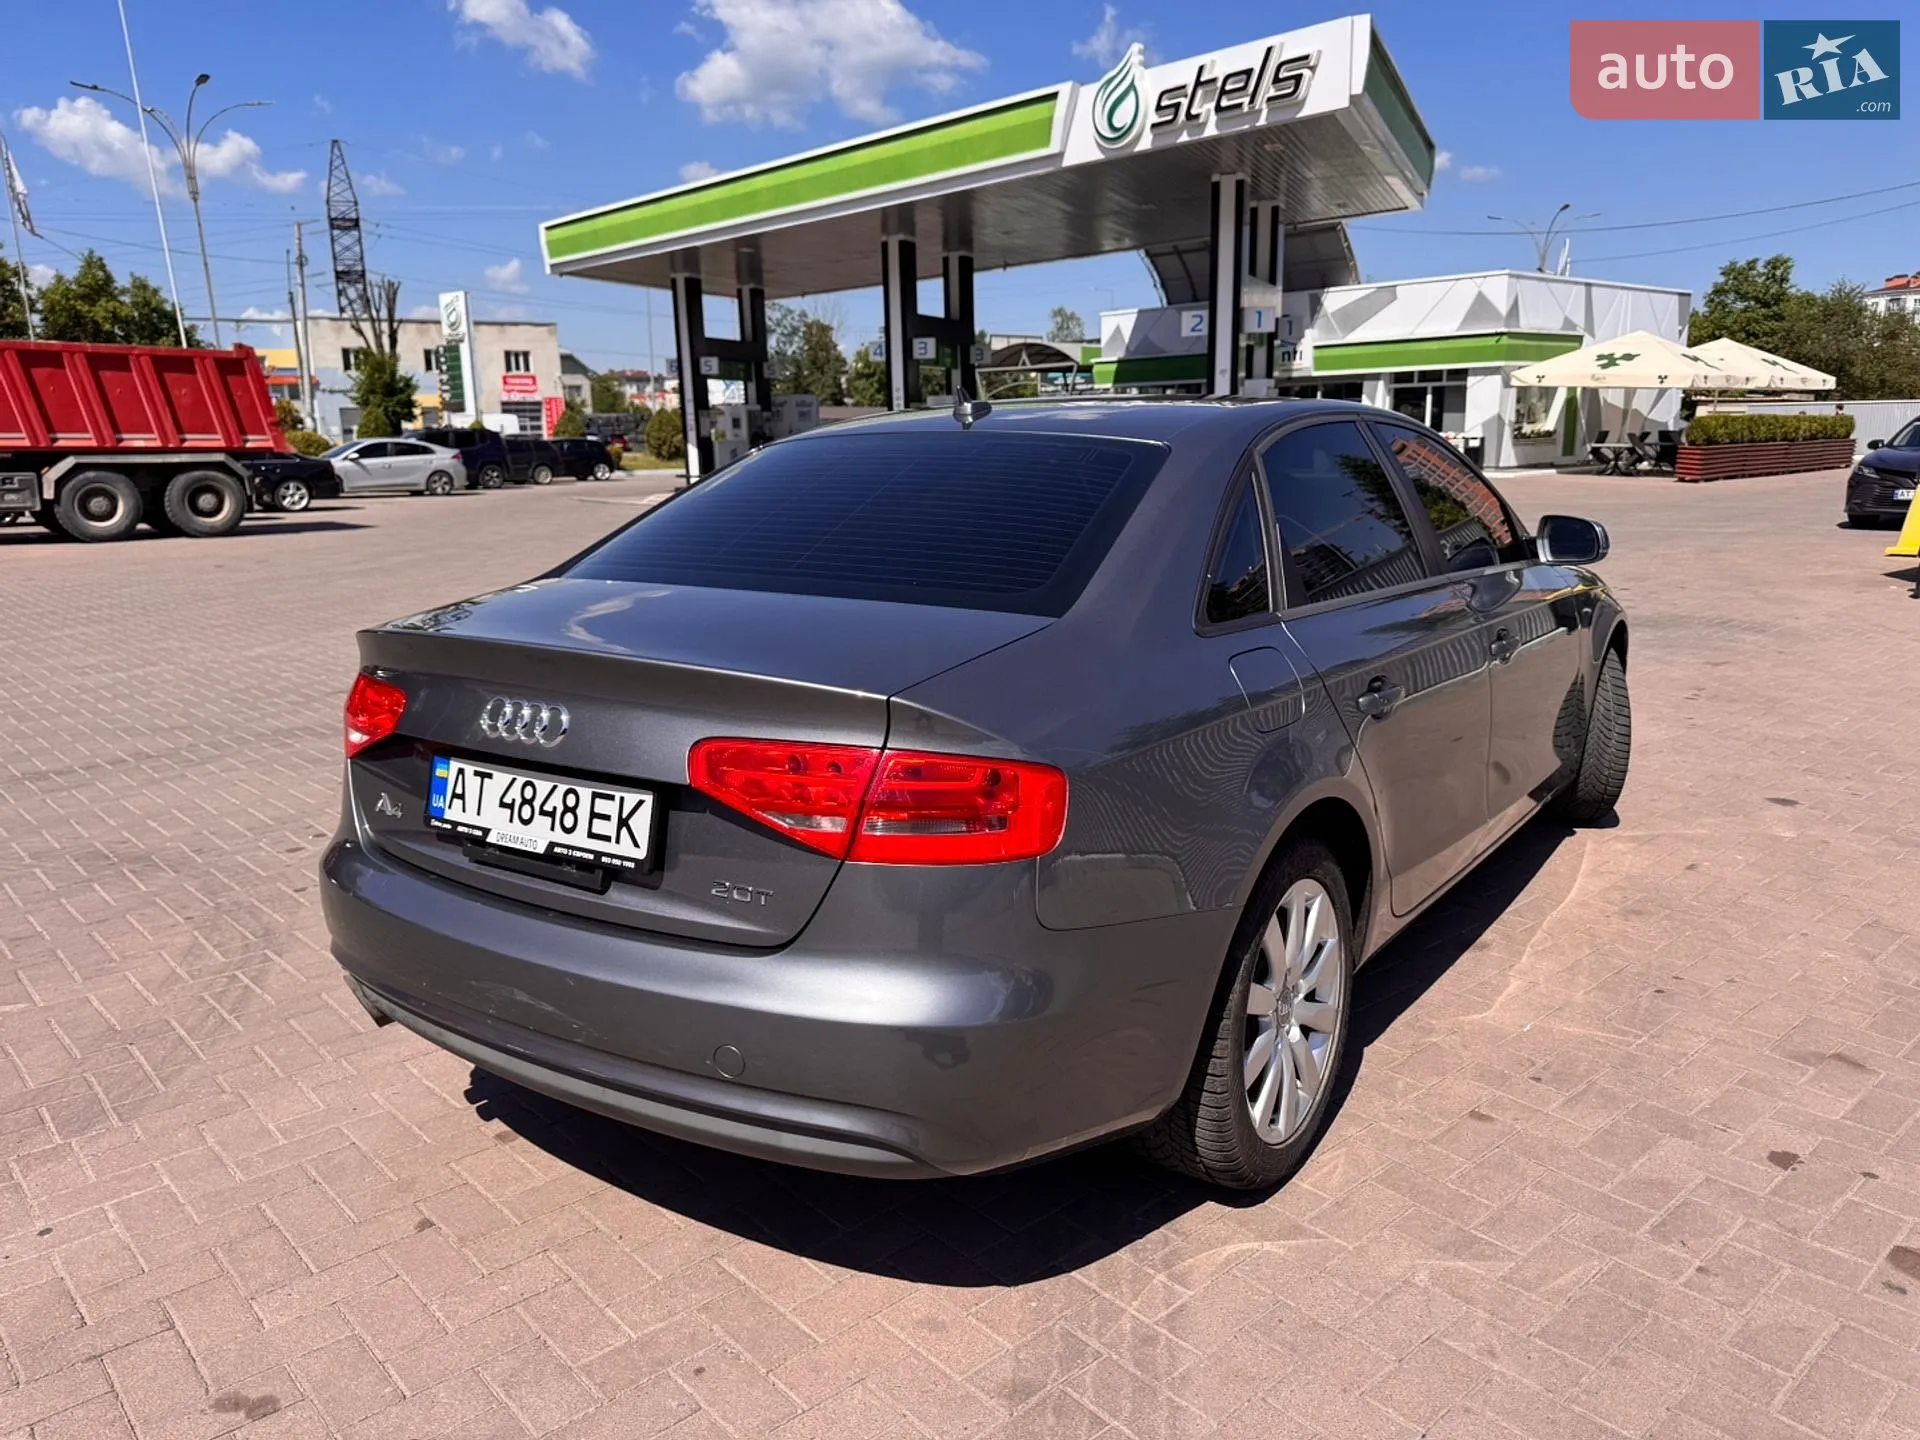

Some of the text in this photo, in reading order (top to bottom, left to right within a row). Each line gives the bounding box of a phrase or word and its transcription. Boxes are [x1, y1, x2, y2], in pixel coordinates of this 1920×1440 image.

[1150, 44, 1314, 132] stels
[1190, 313, 1204, 333] 2
[1255, 310, 1262, 329] 1
[873, 343, 884, 358] 4
[917, 341, 928, 356] 3
[375, 791, 402, 819] A4
[432, 793, 445, 809] UA
[447, 766, 647, 849] AT 4848 EK
